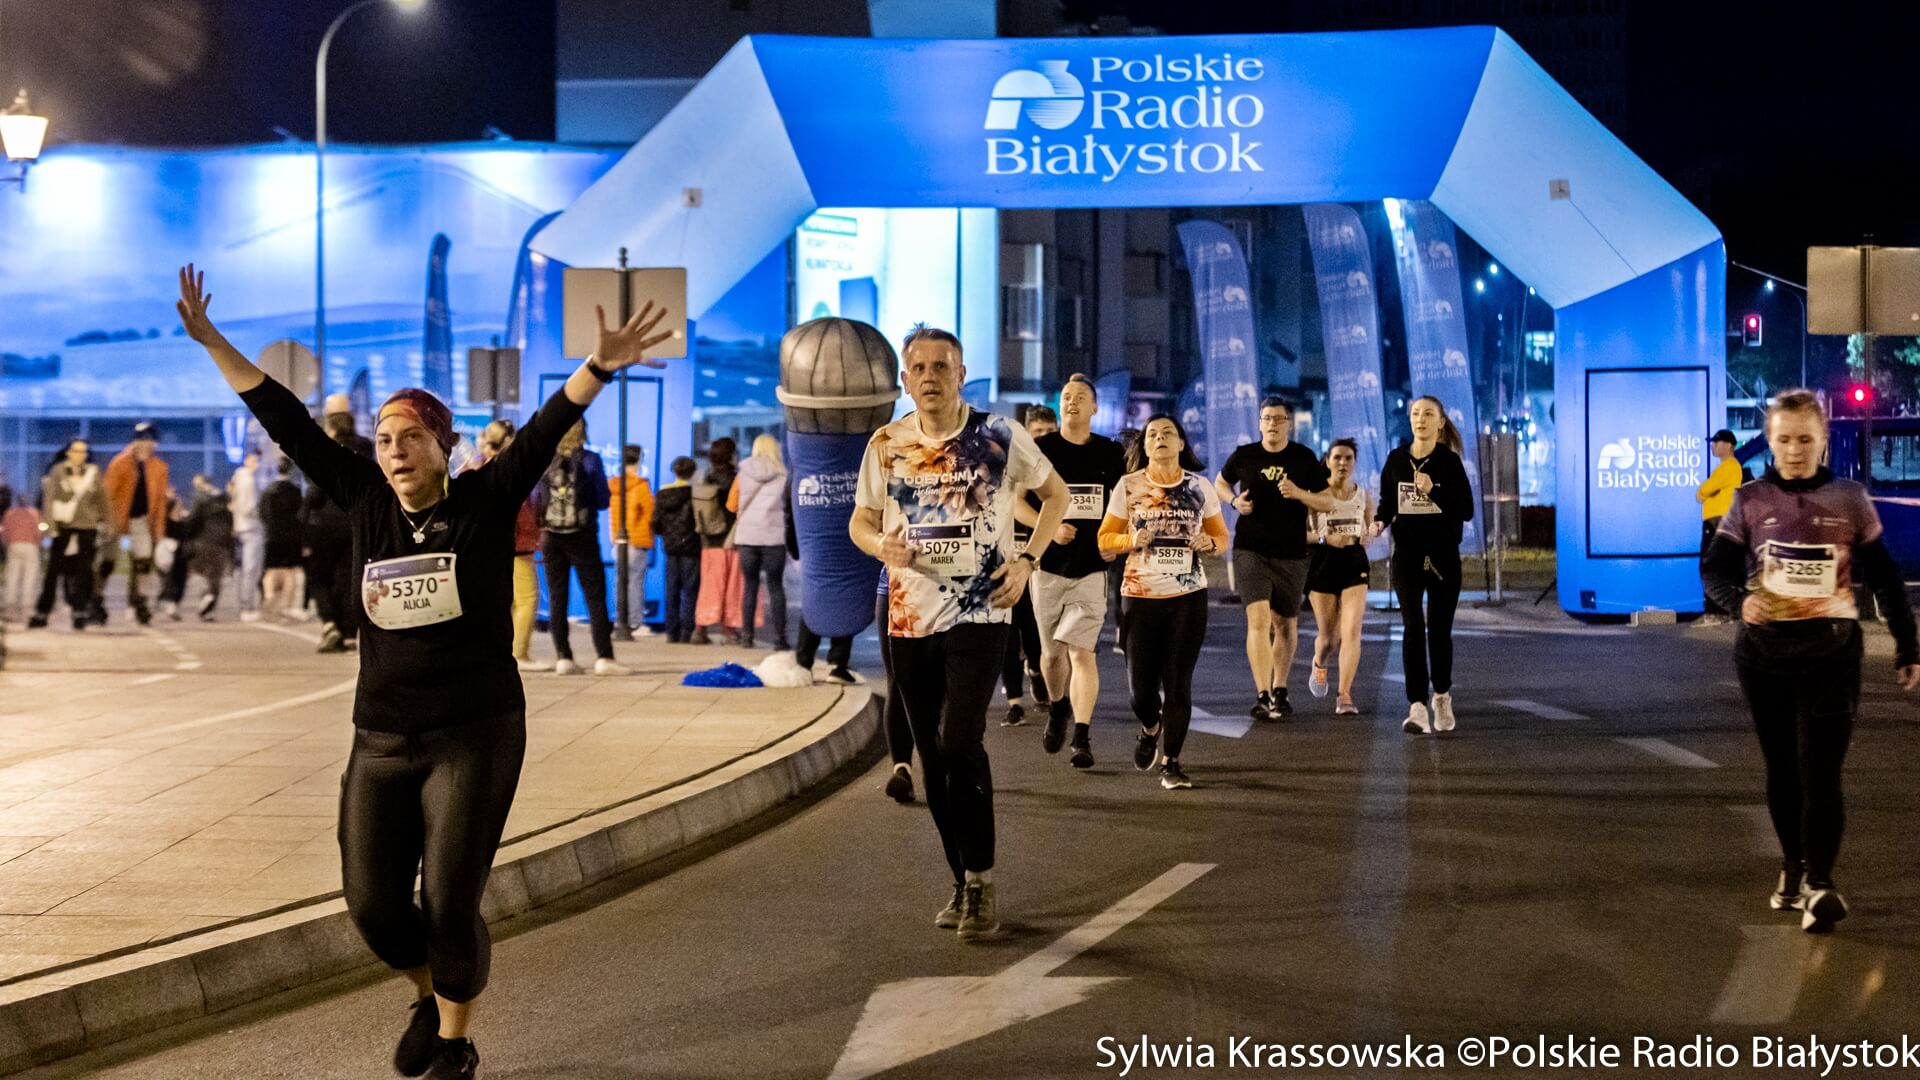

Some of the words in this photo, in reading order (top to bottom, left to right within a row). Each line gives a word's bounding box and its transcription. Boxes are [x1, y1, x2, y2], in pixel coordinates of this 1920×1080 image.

[1091, 53, 1265, 83] Polskie
[1090, 85, 1265, 129] Radio
[984, 132, 1265, 182] Białystok
[1637, 434, 1701, 450] Polskie
[1637, 449, 1701, 469] Radio
[1598, 468, 1701, 492] Białystok
[798, 493, 857, 508] Białysto
[1073, 495, 1096, 505] 5341
[925, 540, 960, 555] 5079
[1158, 548, 1184, 558] 5878
[931, 556, 955, 565] MAREK
[1786, 561, 1823, 576] 5265
[392, 577, 438, 598] 5370
[403, 598, 431, 611] ALICJA
